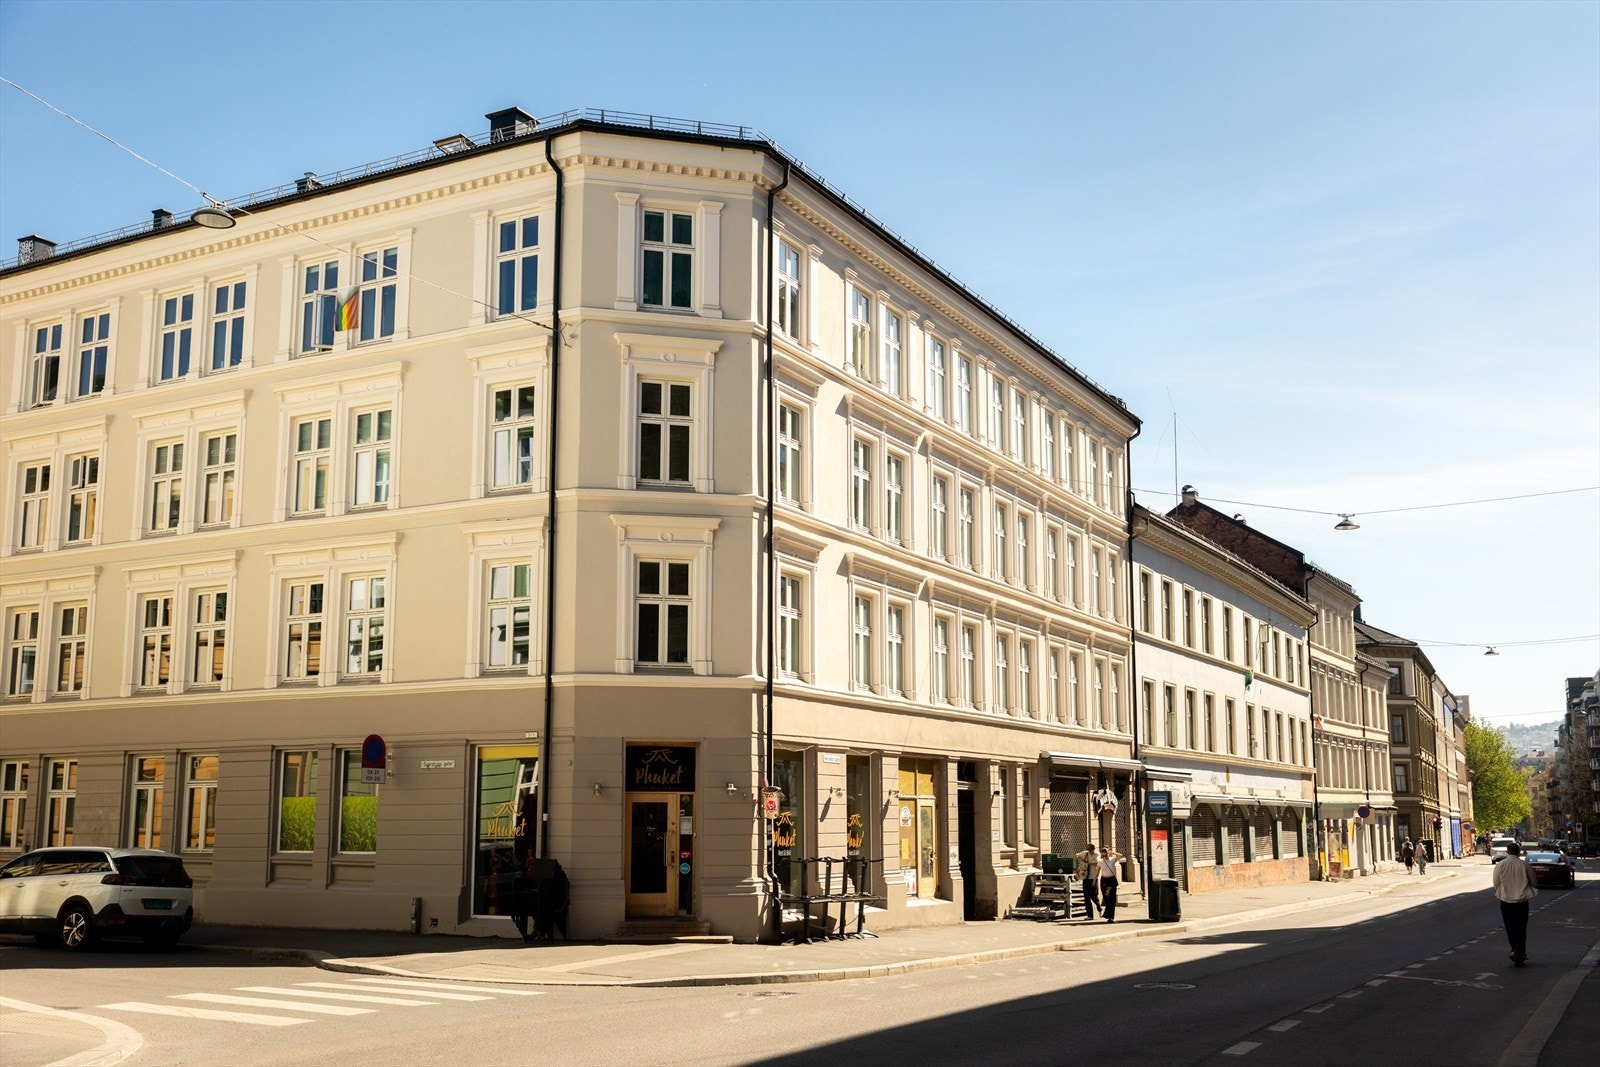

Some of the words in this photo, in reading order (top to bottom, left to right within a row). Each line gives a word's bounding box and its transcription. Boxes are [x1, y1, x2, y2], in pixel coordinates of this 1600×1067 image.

[635, 764, 684, 785] Phuket
[487, 817, 527, 840] Phuket
[772, 827, 797, 848] Phuket
